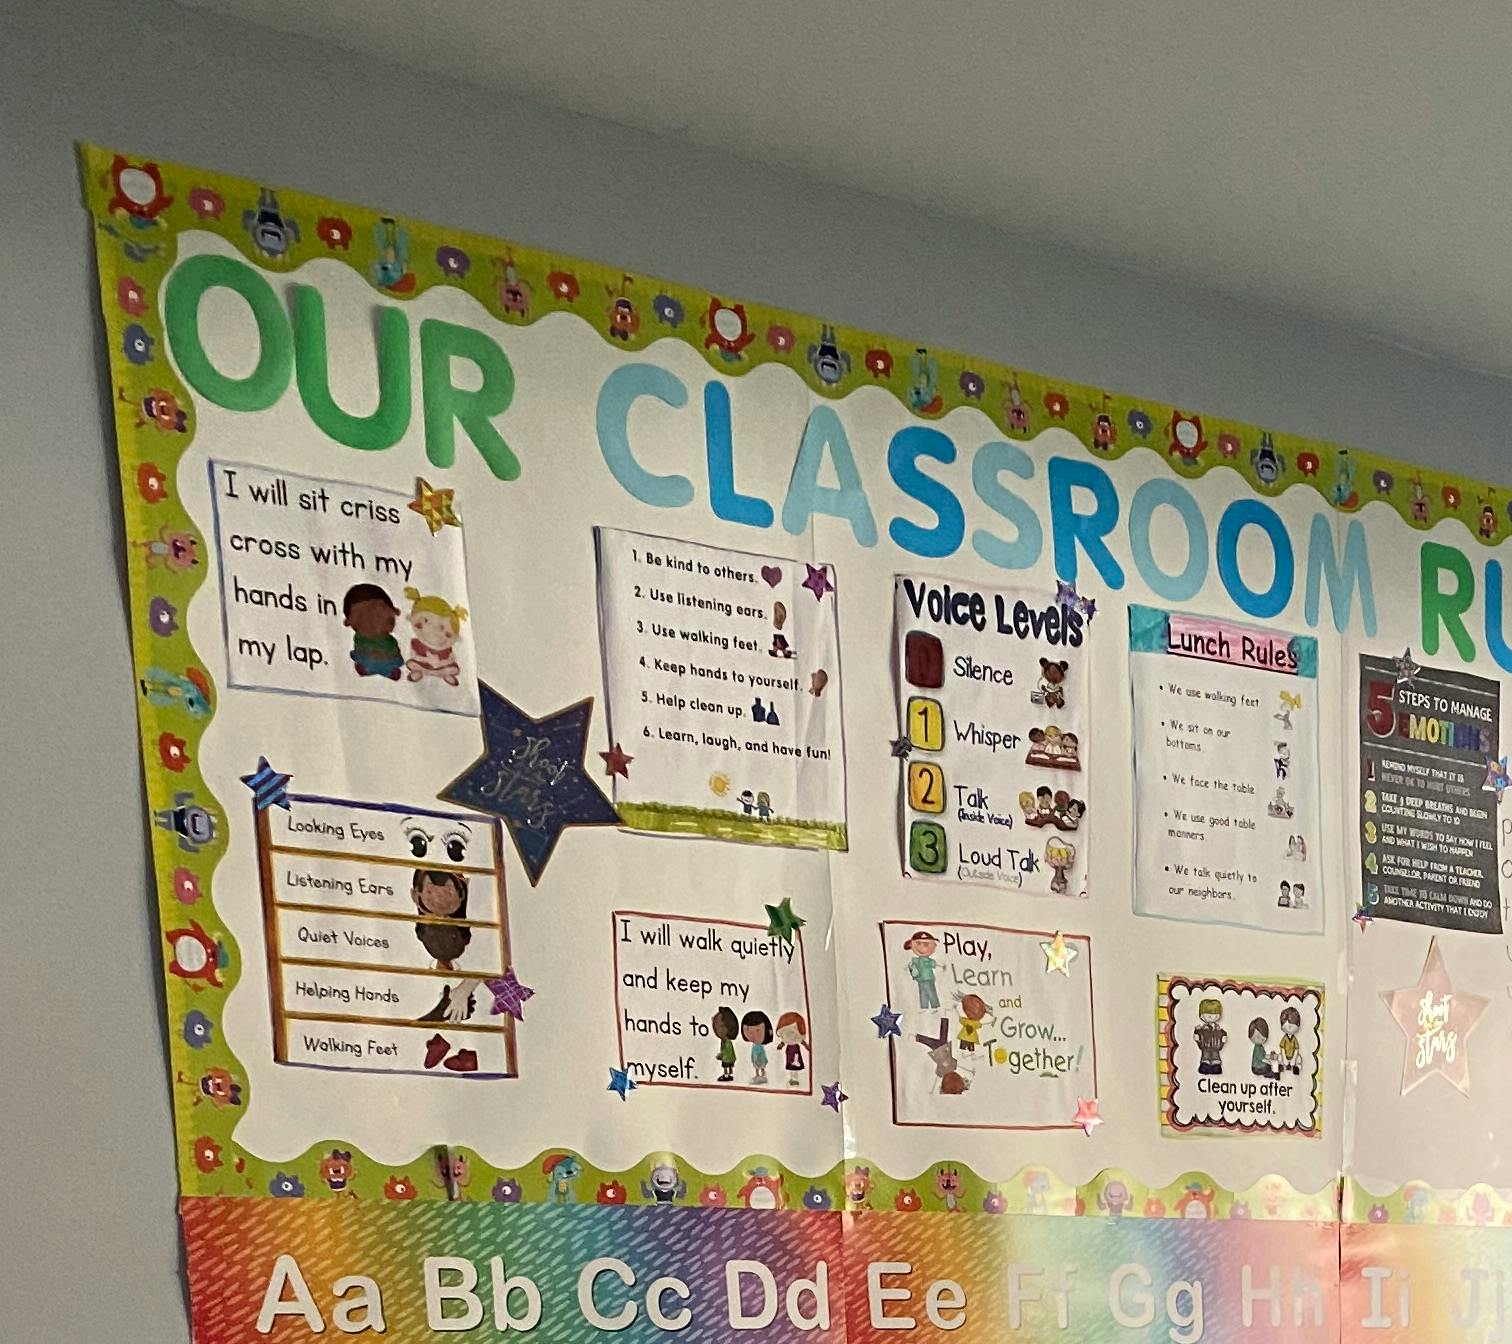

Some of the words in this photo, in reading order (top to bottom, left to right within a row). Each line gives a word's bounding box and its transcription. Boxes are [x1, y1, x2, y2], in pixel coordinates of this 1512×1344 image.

[164, 254, 521, 481] OUR
[596, 363, 1377, 637] CLASSROOM
[223, 471, 239, 498] I
[250, 479, 288, 506] will
[300, 489, 329, 512] sit
[341, 501, 400, 523] criss
[231, 534, 300, 559] cross
[311, 544, 364, 569] with
[375, 559, 412, 581] my
[646, 553, 662, 565] Be
[666, 555, 692, 572] kind
[698, 560, 709, 574] to
[714, 566, 758, 583] others.
[234, 576, 307, 611] hands
[318, 595, 337, 615] in
[634, 586, 644, 598] 2.
[650, 588, 673, 603] Use
[677, 593, 732, 615] listening
[737, 606, 767, 620] ears.
[903, 579, 986, 632] Voice
[995, 595, 1084, 648] Levels
[239, 638, 275, 664] my
[287, 635, 328, 669] lap.
[1168, 622, 1230, 658] Lunch
[1243, 636, 1298, 669] Rules
[954, 656, 1014, 686] Silence
[1169, 684, 1182, 695] We
[1186, 689, 1201, 698] use
[1205, 692, 1236, 706] walking
[1399, 690, 1430, 708] STEPS
[1433, 698, 1448, 712] TO
[1451, 701, 1492, 722] MANAGE
[643, 727, 654, 738] 6.
[659, 728, 698, 745] Learn,
[703, 733, 741, 750] laugh,
[745, 740, 768, 752] and
[773, 742, 801, 757] have
[807, 746, 831, 760] fun!
[918, 707, 929, 742] 1
[954, 721, 1021, 749] Whisper
[918, 768, 935, 804] 2
[954, 786, 989, 809] Talk
[1172, 773, 1186, 785] We
[1190, 775, 1209, 788] face
[1214, 780, 1228, 791] the
[288, 816, 344, 840] Looking
[351, 823, 384, 841] Eyes
[918, 830, 939, 866] 3
[959, 844, 1000, 868] Loud
[1008, 849, 1039, 872] Talk
[288, 870, 352, 895] Listening
[359, 878, 394, 896] Ears
[298, 927, 338, 945] Quiet
[343, 931, 389, 949] Voices
[620, 920, 632, 942] I
[641, 924, 670, 946] will
[680, 928, 722, 951] walk
[731, 937, 795, 964] quietly
[944, 932, 992, 962] Play,
[623, 967, 657, 990] and
[667, 968, 712, 999] keep
[721, 982, 749, 1003] my
[951, 963, 1013, 986] Learn
[296, 981, 350, 1003] Helping
[356, 987, 399, 1002] Hands
[999, 995, 1022, 1008] and
[625, 1009, 681, 1035] hands
[691, 1017, 709, 1036] to
[1000, 1016, 1066, 1042] Grow...
[304, 1036, 362, 1057] Walking
[368, 1040, 398, 1056] Feet
[984, 1039, 1084, 1074] Together!
[627, 1057, 698, 1082] myself.
[1198, 1078, 1236, 1094] Clean
[1241, 1083, 1256, 1098] up
[1260, 1082, 1293, 1096] after
[1219, 1100, 1276, 1114] yourself.
[255, 1254, 386, 1335] Aa
[423, 1255, 542, 1332] Bb
[577, 1257, 693, 1332] Cc
[726, 1259, 831, 1332] Dd
[866, 1262, 967, 1330] Ee
